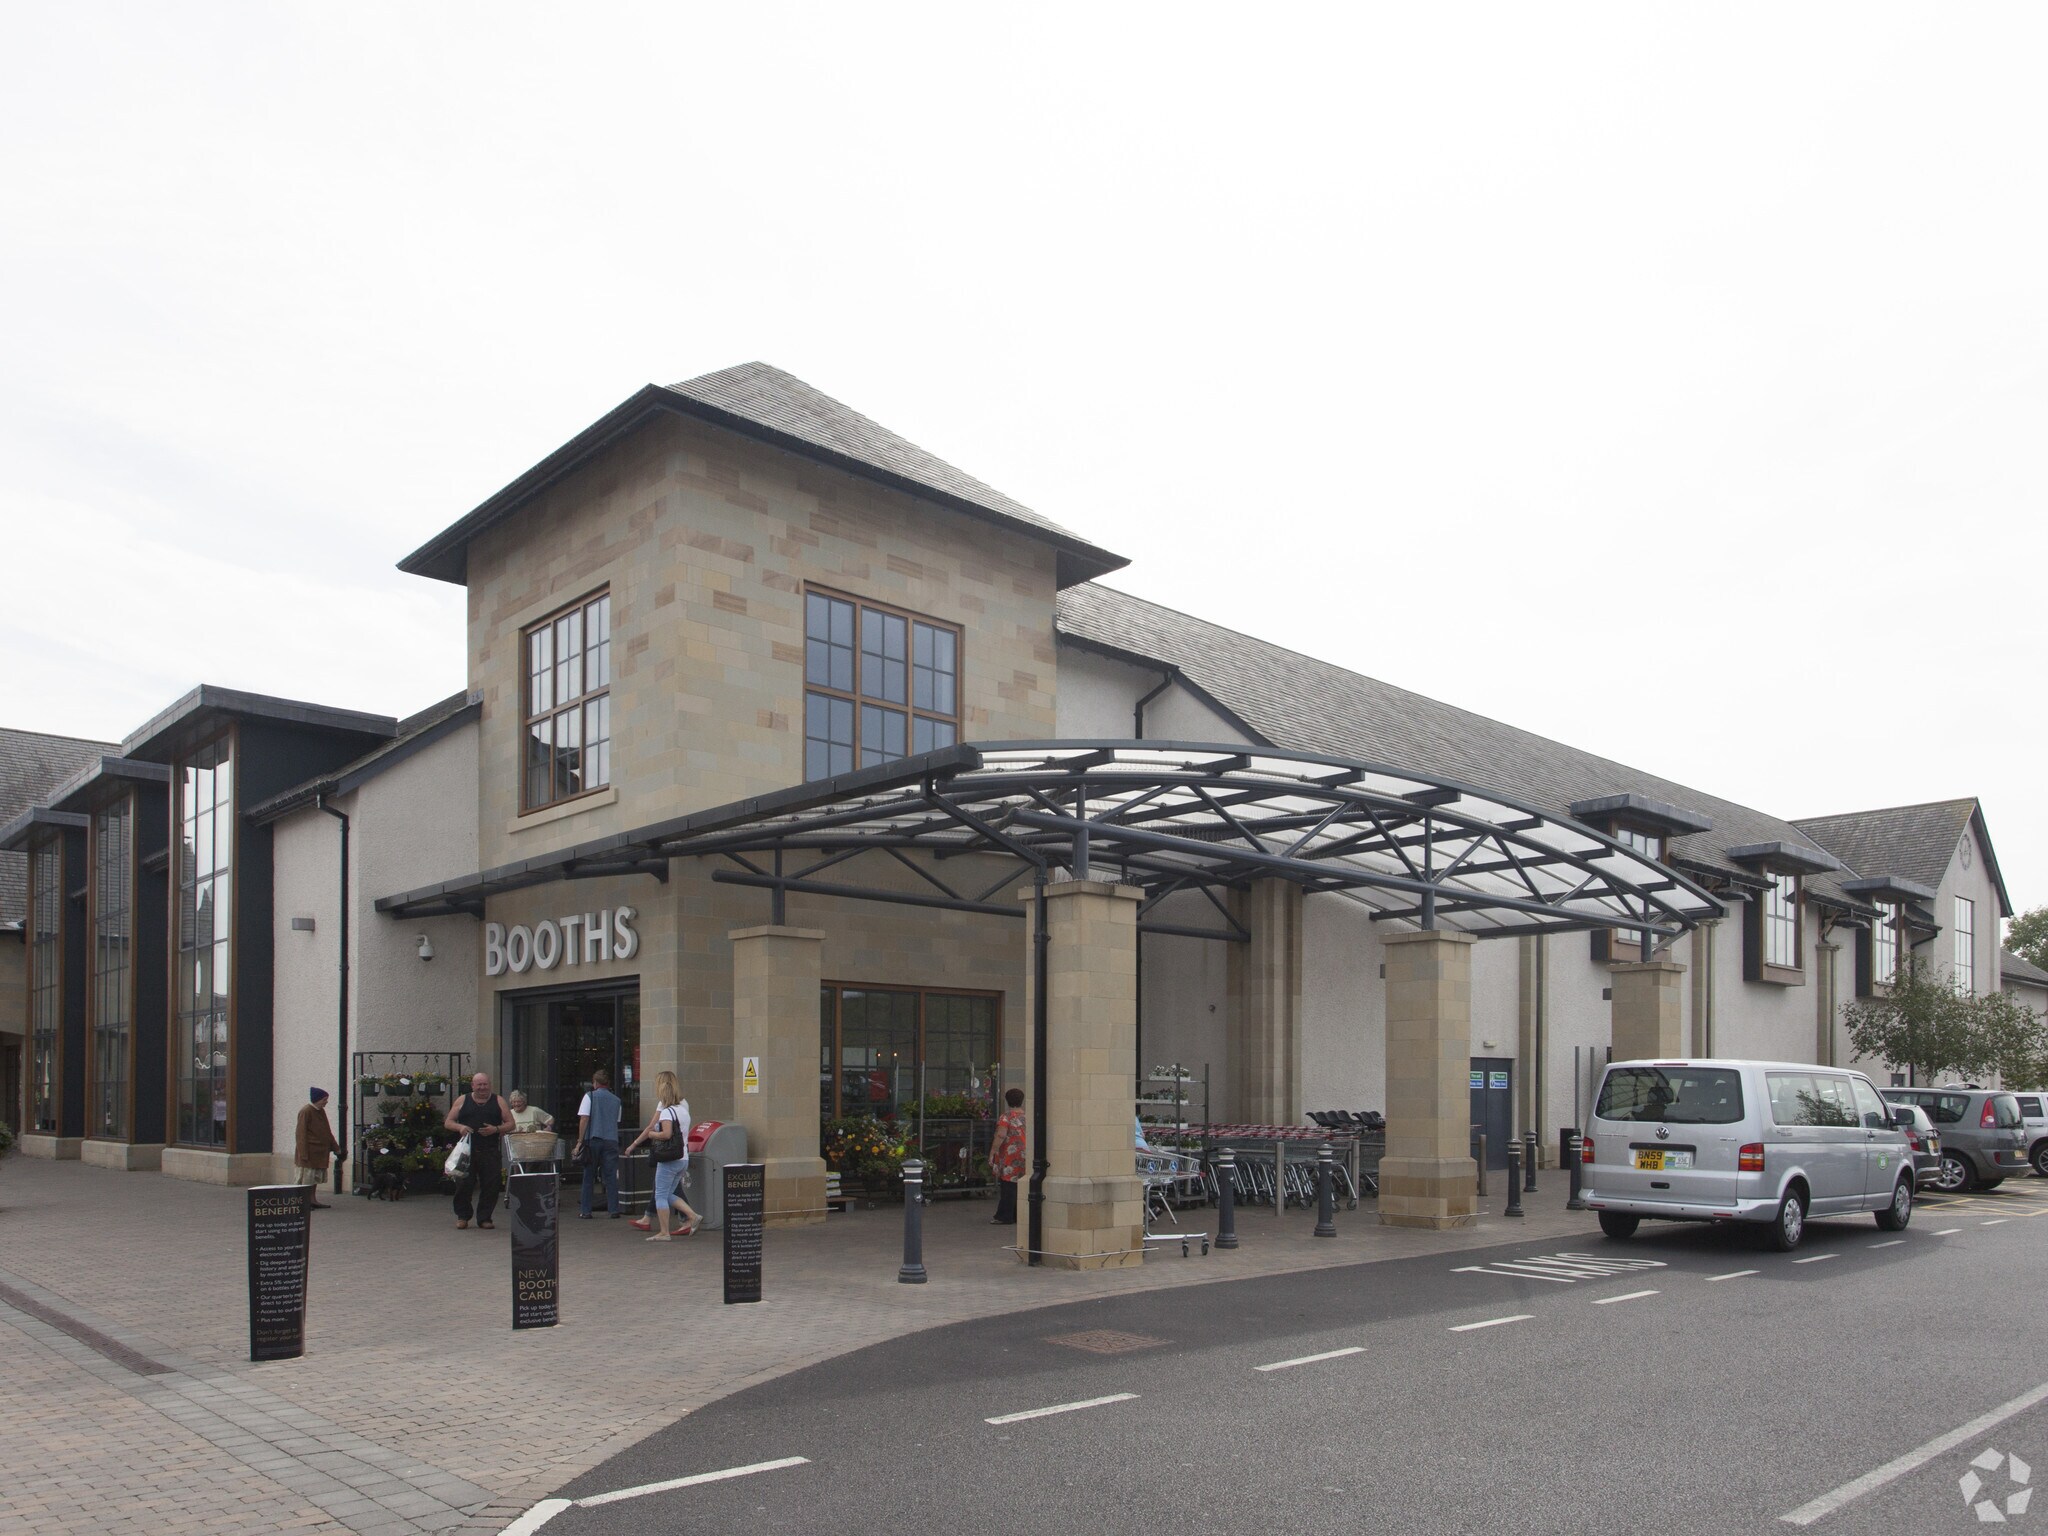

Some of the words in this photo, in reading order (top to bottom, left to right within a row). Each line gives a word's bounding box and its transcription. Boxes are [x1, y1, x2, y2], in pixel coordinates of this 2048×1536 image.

[485, 905, 639, 976] BOOTHS
[1638, 1151, 1662, 1160] BN59
[1640, 1160, 1658, 1169] WHB
[254, 1196, 304, 1207] EXCLUSIVE
[255, 1206, 300, 1216] BENEFITS
[1449, 1252, 1668, 1283] TAXIS
[518, 1268, 548, 1279] NEW
[520, 1290, 552, 1300] CARD
